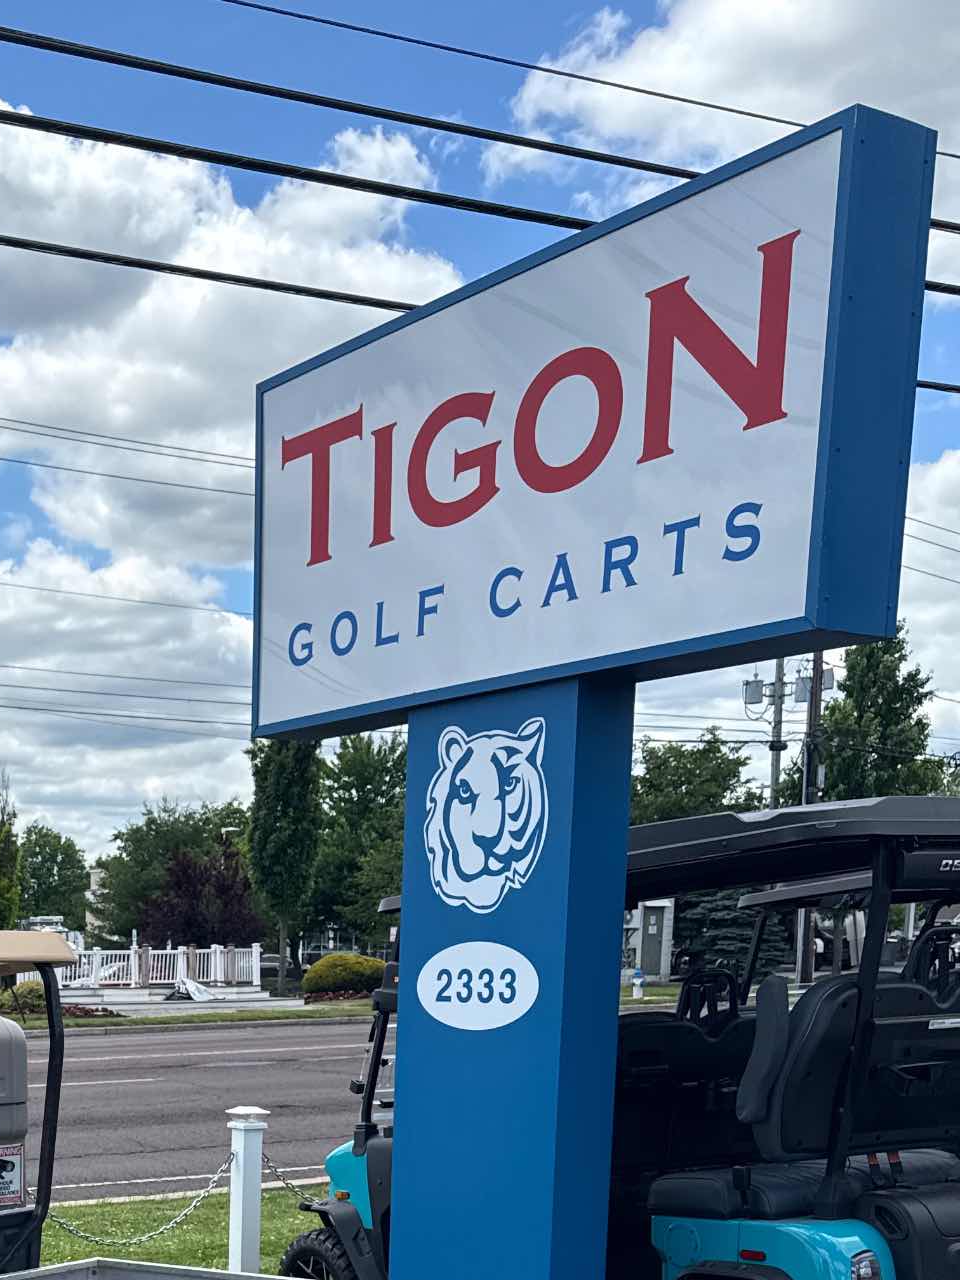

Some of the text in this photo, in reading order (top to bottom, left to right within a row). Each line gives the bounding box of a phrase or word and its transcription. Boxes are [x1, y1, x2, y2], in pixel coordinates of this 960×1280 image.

[281, 229, 800, 567] TIGON
[288, 502, 764, 667] GOLF CARTS
[435, 968, 517, 1004] 2333
